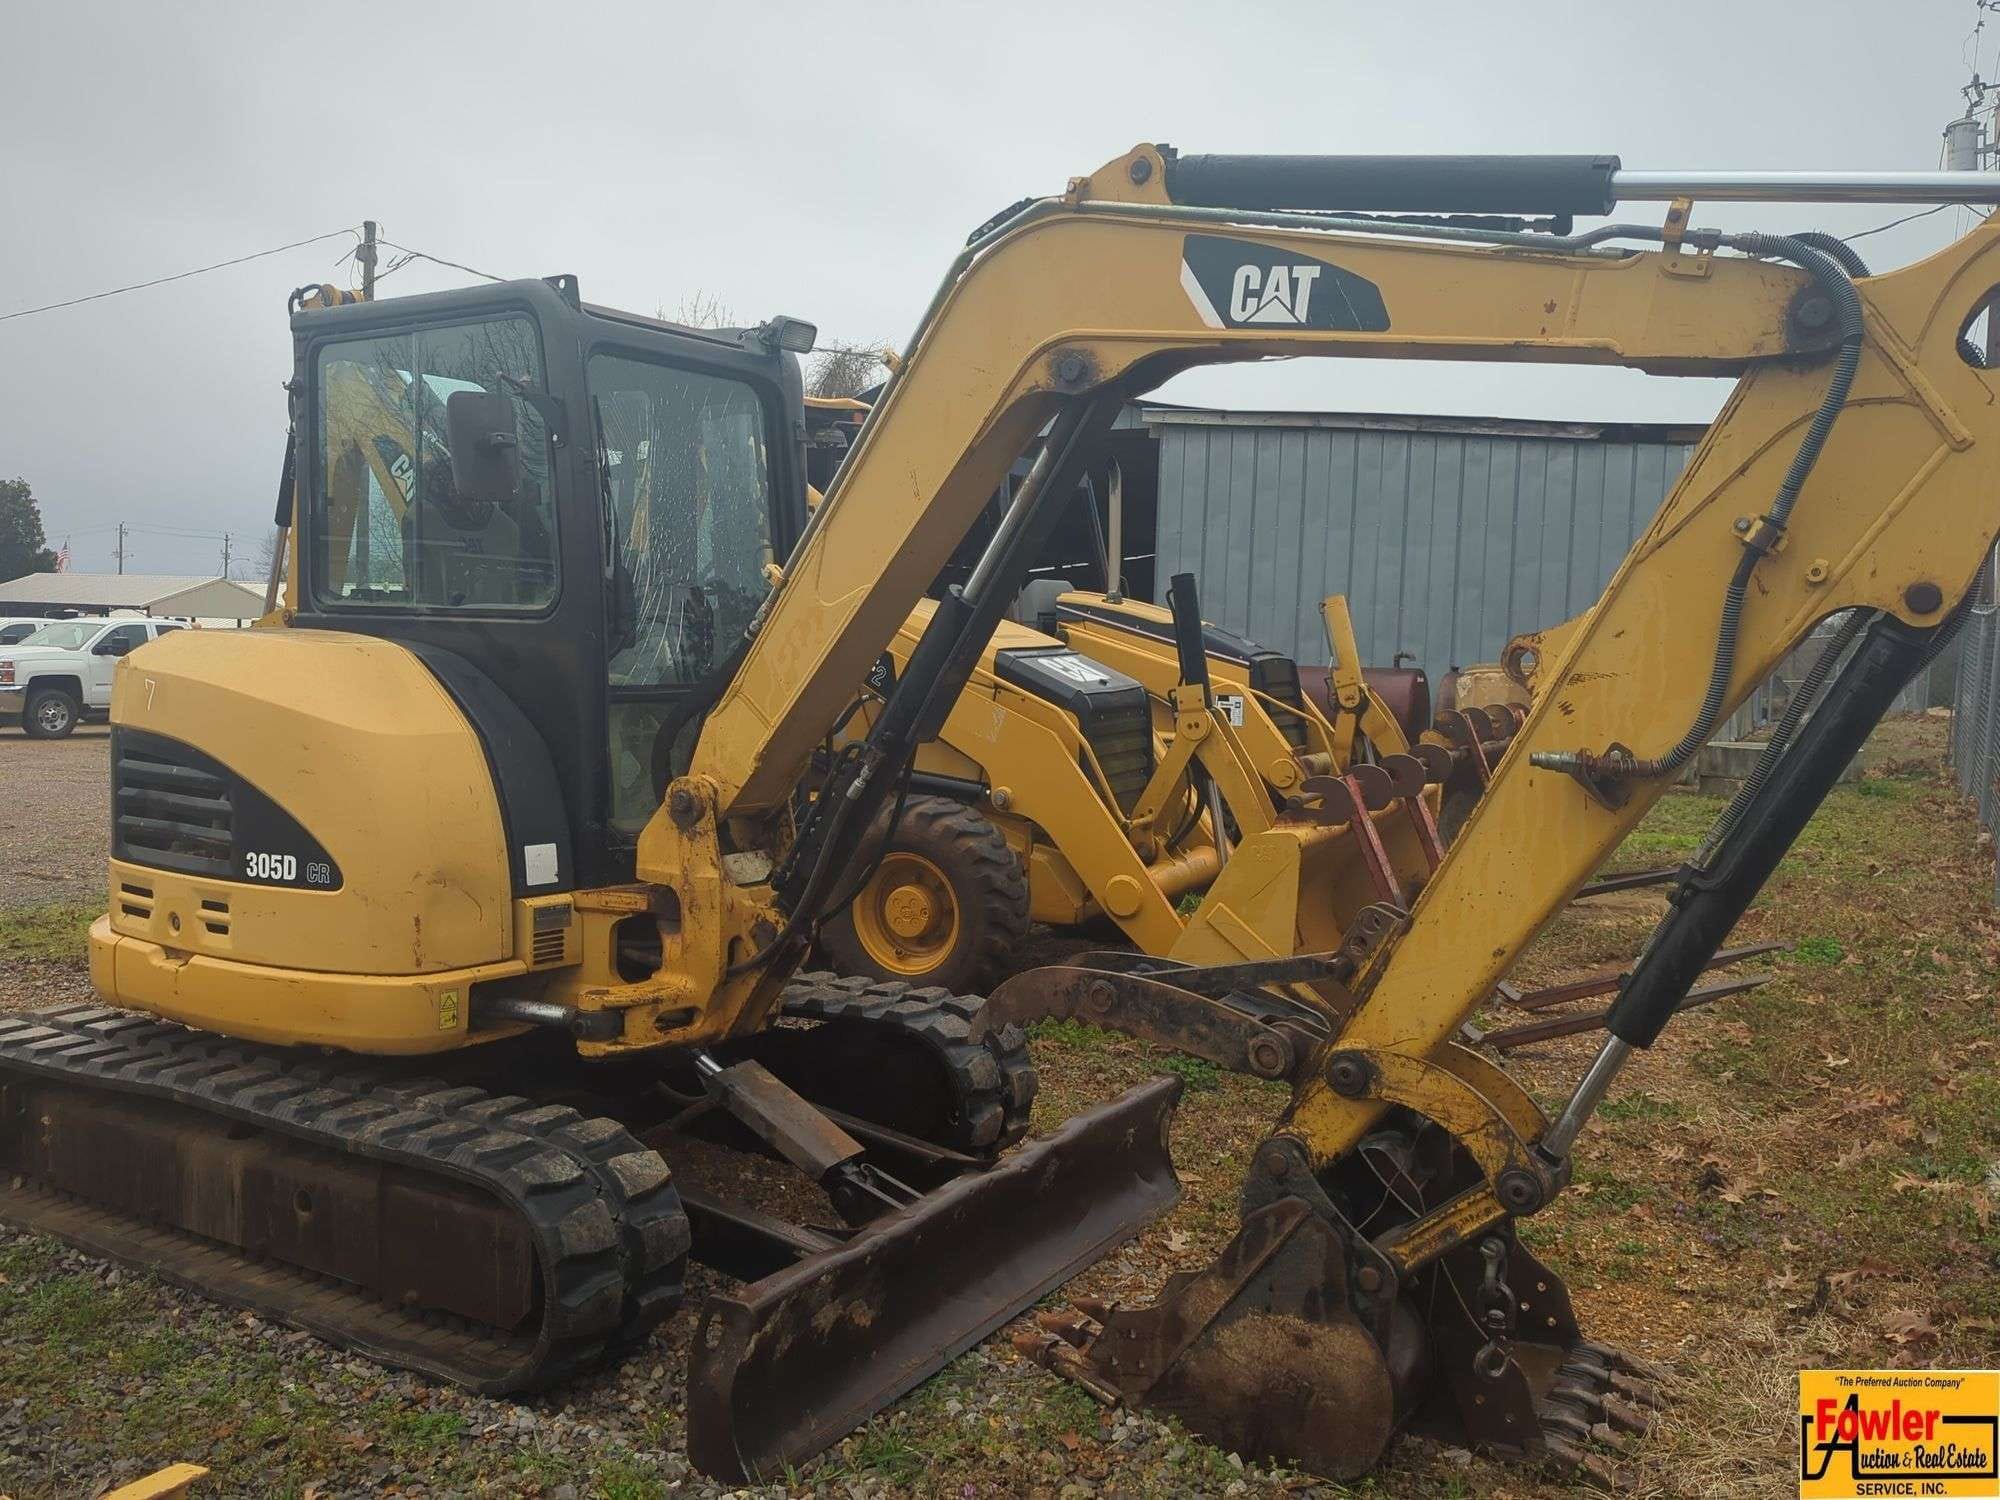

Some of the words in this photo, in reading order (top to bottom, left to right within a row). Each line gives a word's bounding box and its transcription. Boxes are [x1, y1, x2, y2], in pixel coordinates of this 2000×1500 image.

[1229, 264, 1321, 323] CAT
[145, 678, 156, 711] 7
[246, 852, 297, 880] 305D
[306, 862, 330, 884] CR
